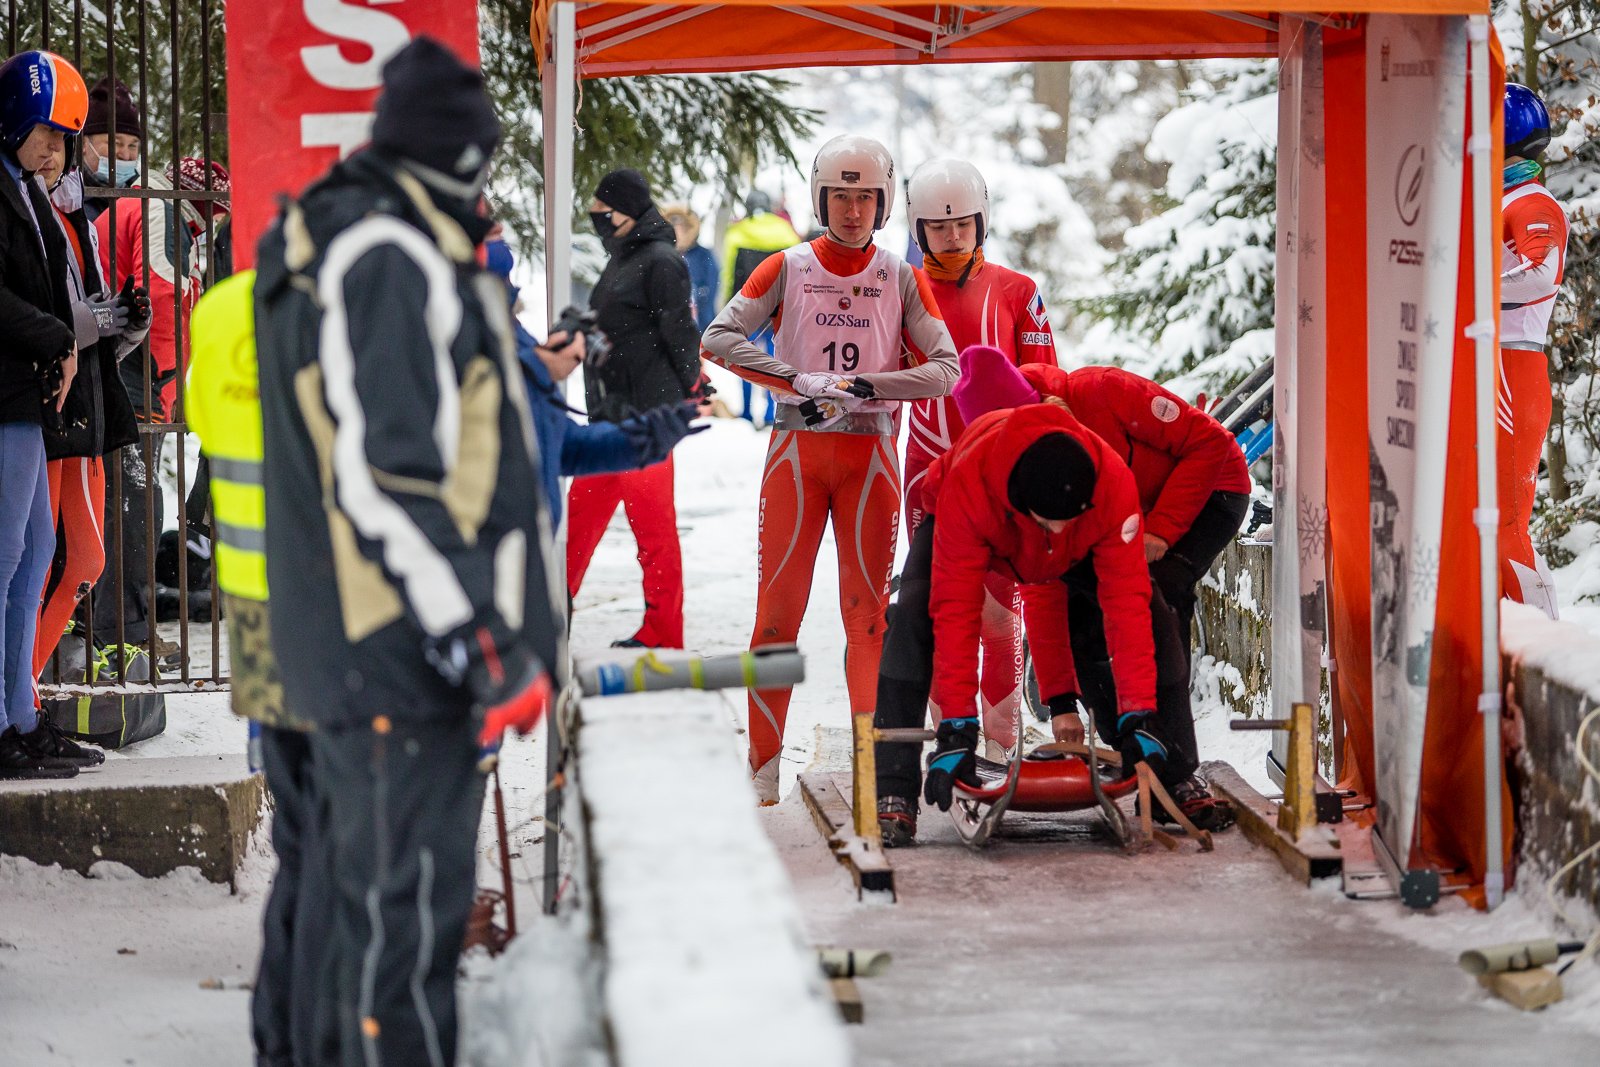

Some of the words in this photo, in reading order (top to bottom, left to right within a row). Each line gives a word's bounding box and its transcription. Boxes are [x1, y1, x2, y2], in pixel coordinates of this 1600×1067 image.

[29, 64, 41, 96] uvex
[815, 312, 870, 328] OZSSan
[822, 341, 860, 372] 19
[882, 510, 899, 595] POLAND
[1011, 708, 1020, 737] MKS
